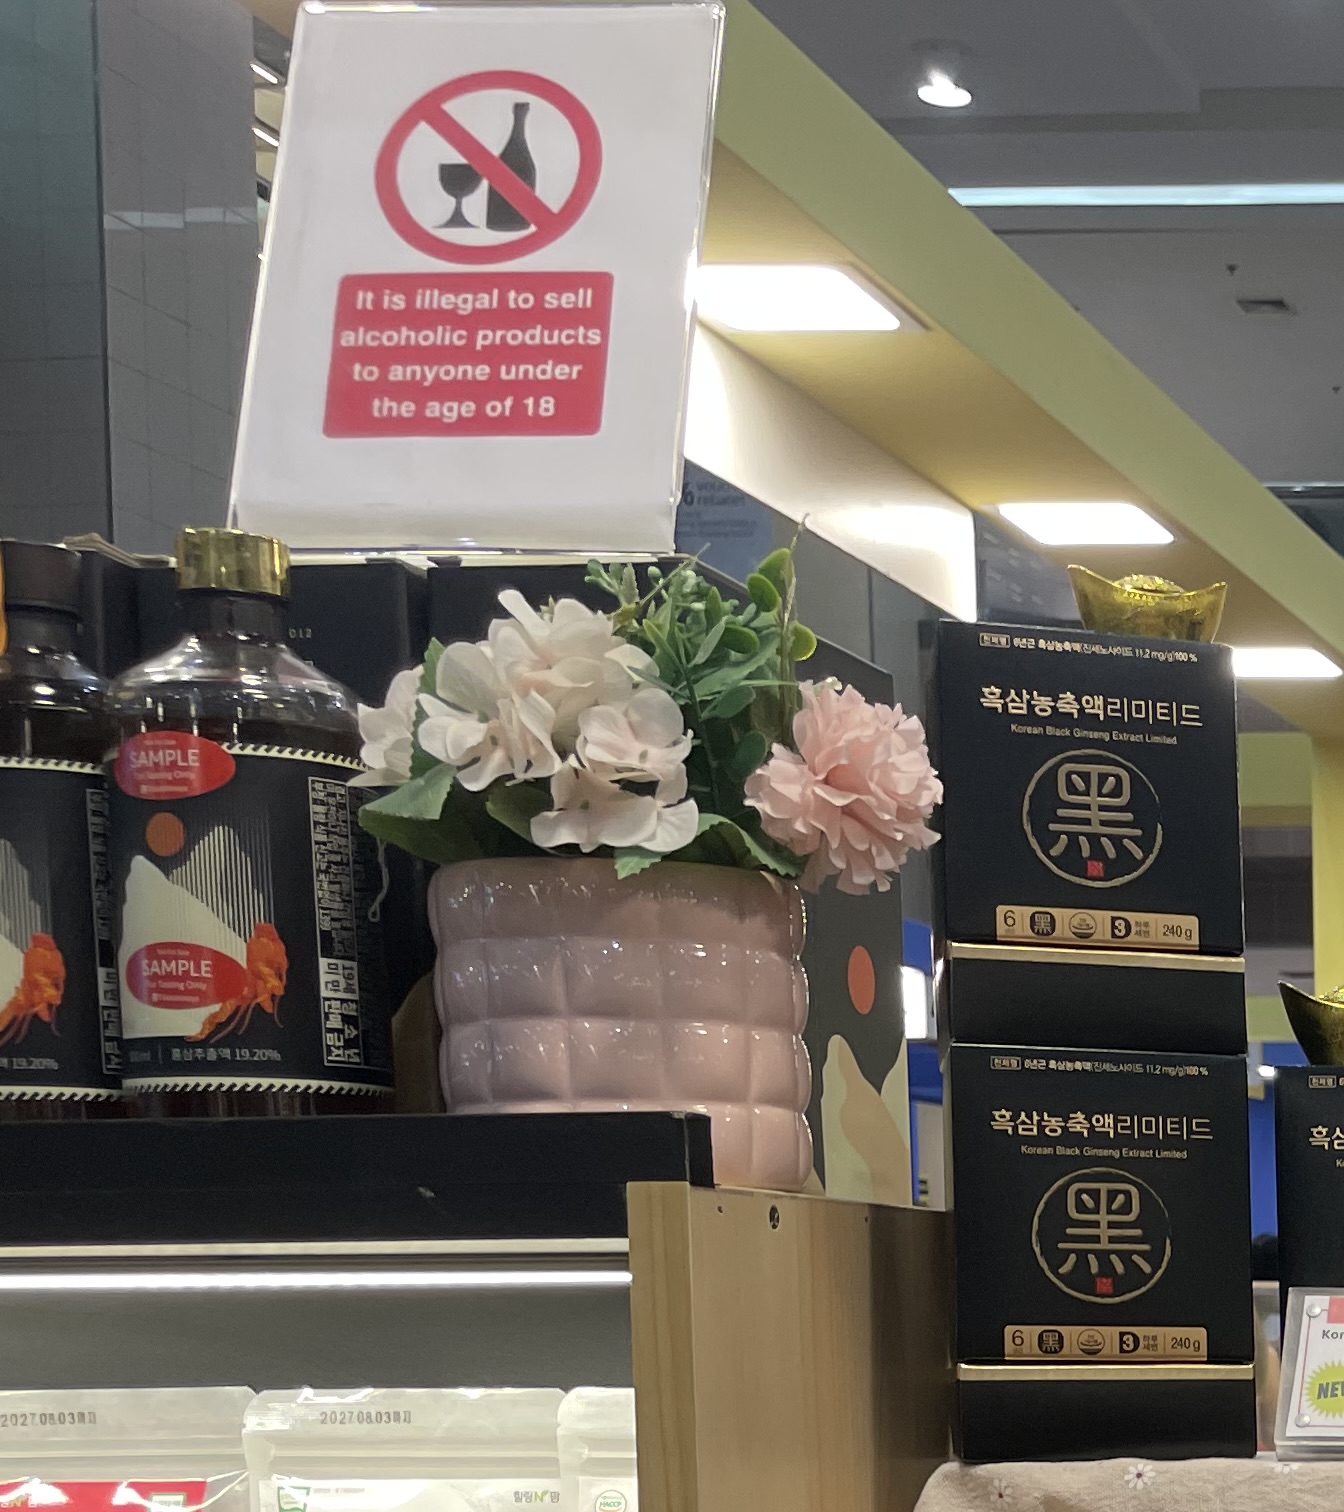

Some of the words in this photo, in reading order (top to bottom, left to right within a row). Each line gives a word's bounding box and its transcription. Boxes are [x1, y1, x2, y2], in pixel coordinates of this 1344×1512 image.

[356, 290, 378, 308] It
[383, 290, 406, 308] is
[416, 289, 498, 313] illegal
[508, 290, 534, 308] to
[545, 289, 591, 307] sell
[341, 326, 467, 346] alcoholic
[476, 326, 602, 350] products
[353, 362, 379, 380] to
[388, 364, 490, 385] anyone
[500, 361, 581, 380] under
[373, 397, 415, 415] the
[425, 401, 475, 420] age
[485, 397, 510, 415] of
[523, 397, 555, 415] 18
[979, 685, 1203, 728] 흑삼농축액리미티드
[1048, 762, 1144, 861] 黑
[142, 960, 213, 978] SAMPLE
[990, 1109, 1213, 1140] 흑삼농축액리미티드
